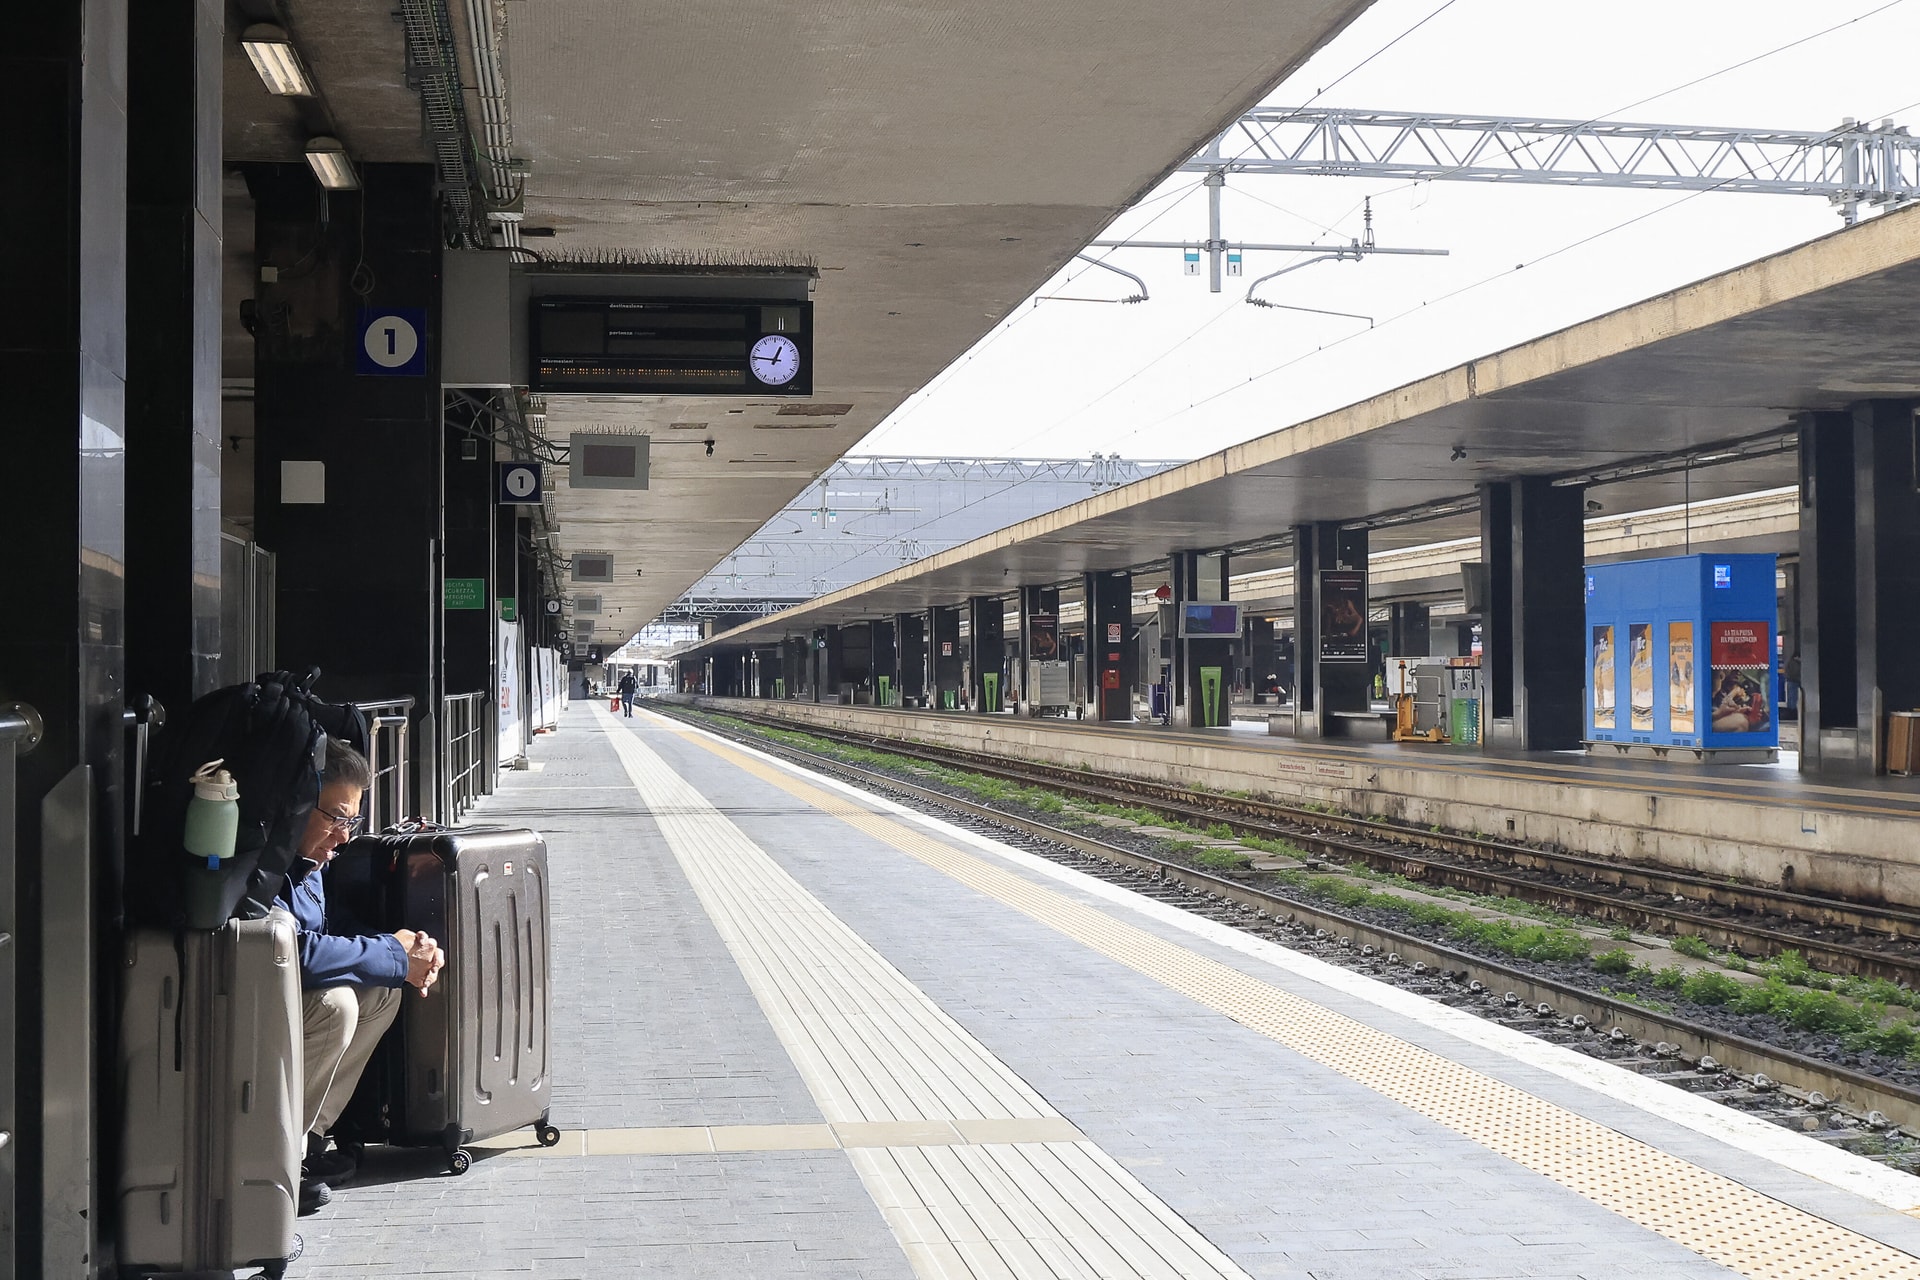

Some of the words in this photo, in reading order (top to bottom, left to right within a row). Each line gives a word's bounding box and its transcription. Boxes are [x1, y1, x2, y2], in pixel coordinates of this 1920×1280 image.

[1190, 264, 1194, 273] 1
[1233, 265, 1236, 273] 1
[384, 328, 396, 355] 1
[517, 475, 525, 489] 1
